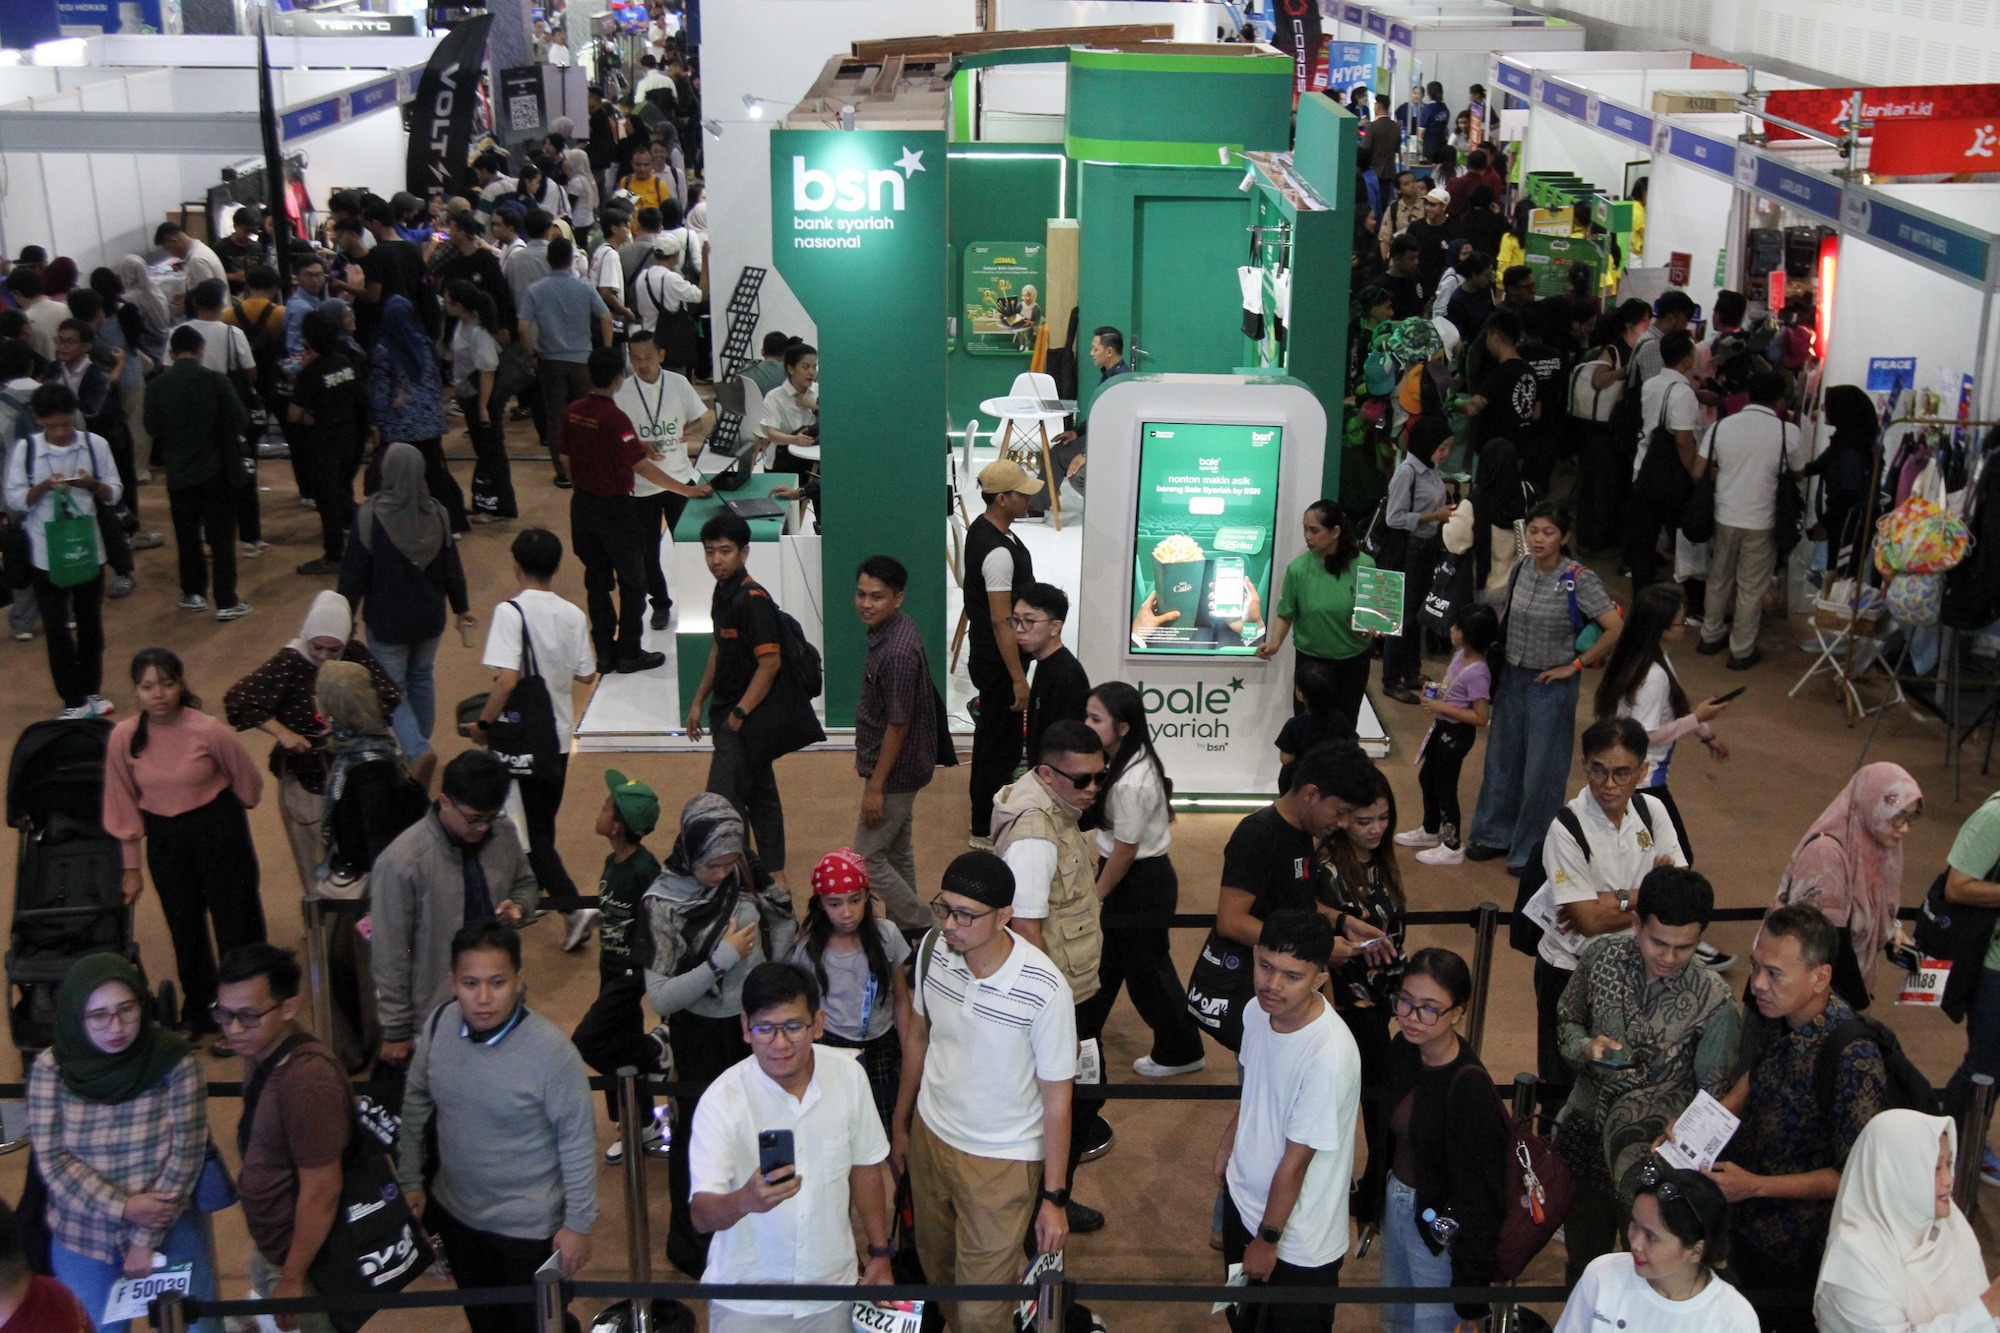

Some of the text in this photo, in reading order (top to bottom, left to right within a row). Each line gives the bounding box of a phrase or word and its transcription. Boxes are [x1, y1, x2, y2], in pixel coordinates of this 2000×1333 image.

[1293, 19, 1306, 92] COROS
[1331, 63, 1372, 83] HYPE
[430, 62, 460, 158] VOLT
[1861, 102, 1934, 117] larilari.id
[793, 155, 905, 212] bsn
[794, 216, 894, 233] bank syariah
[794, 235, 861, 248] nasional
[1873, 361, 1912, 369] PEACE
[639, 421, 676, 438] bale
[1252, 432, 1271, 441] bsn
[1199, 457, 1219, 466] bale
[1168, 476, 1251, 485] nonton makin asik
[1156, 485, 1183, 494] bareng
[1203, 486, 1231, 495] Syariah
[1233, 487, 1242, 495] by
[1244, 487, 1261, 495] BSN
[1173, 584, 1192, 593] Café
[1138, 681, 1230, 714] bale
[1147, 718, 1229, 743] yariah
[1207, 743, 1225, 751] bsn
[117, 1285, 128, 1303] F
[853, 1303, 896, 1333] 2232
